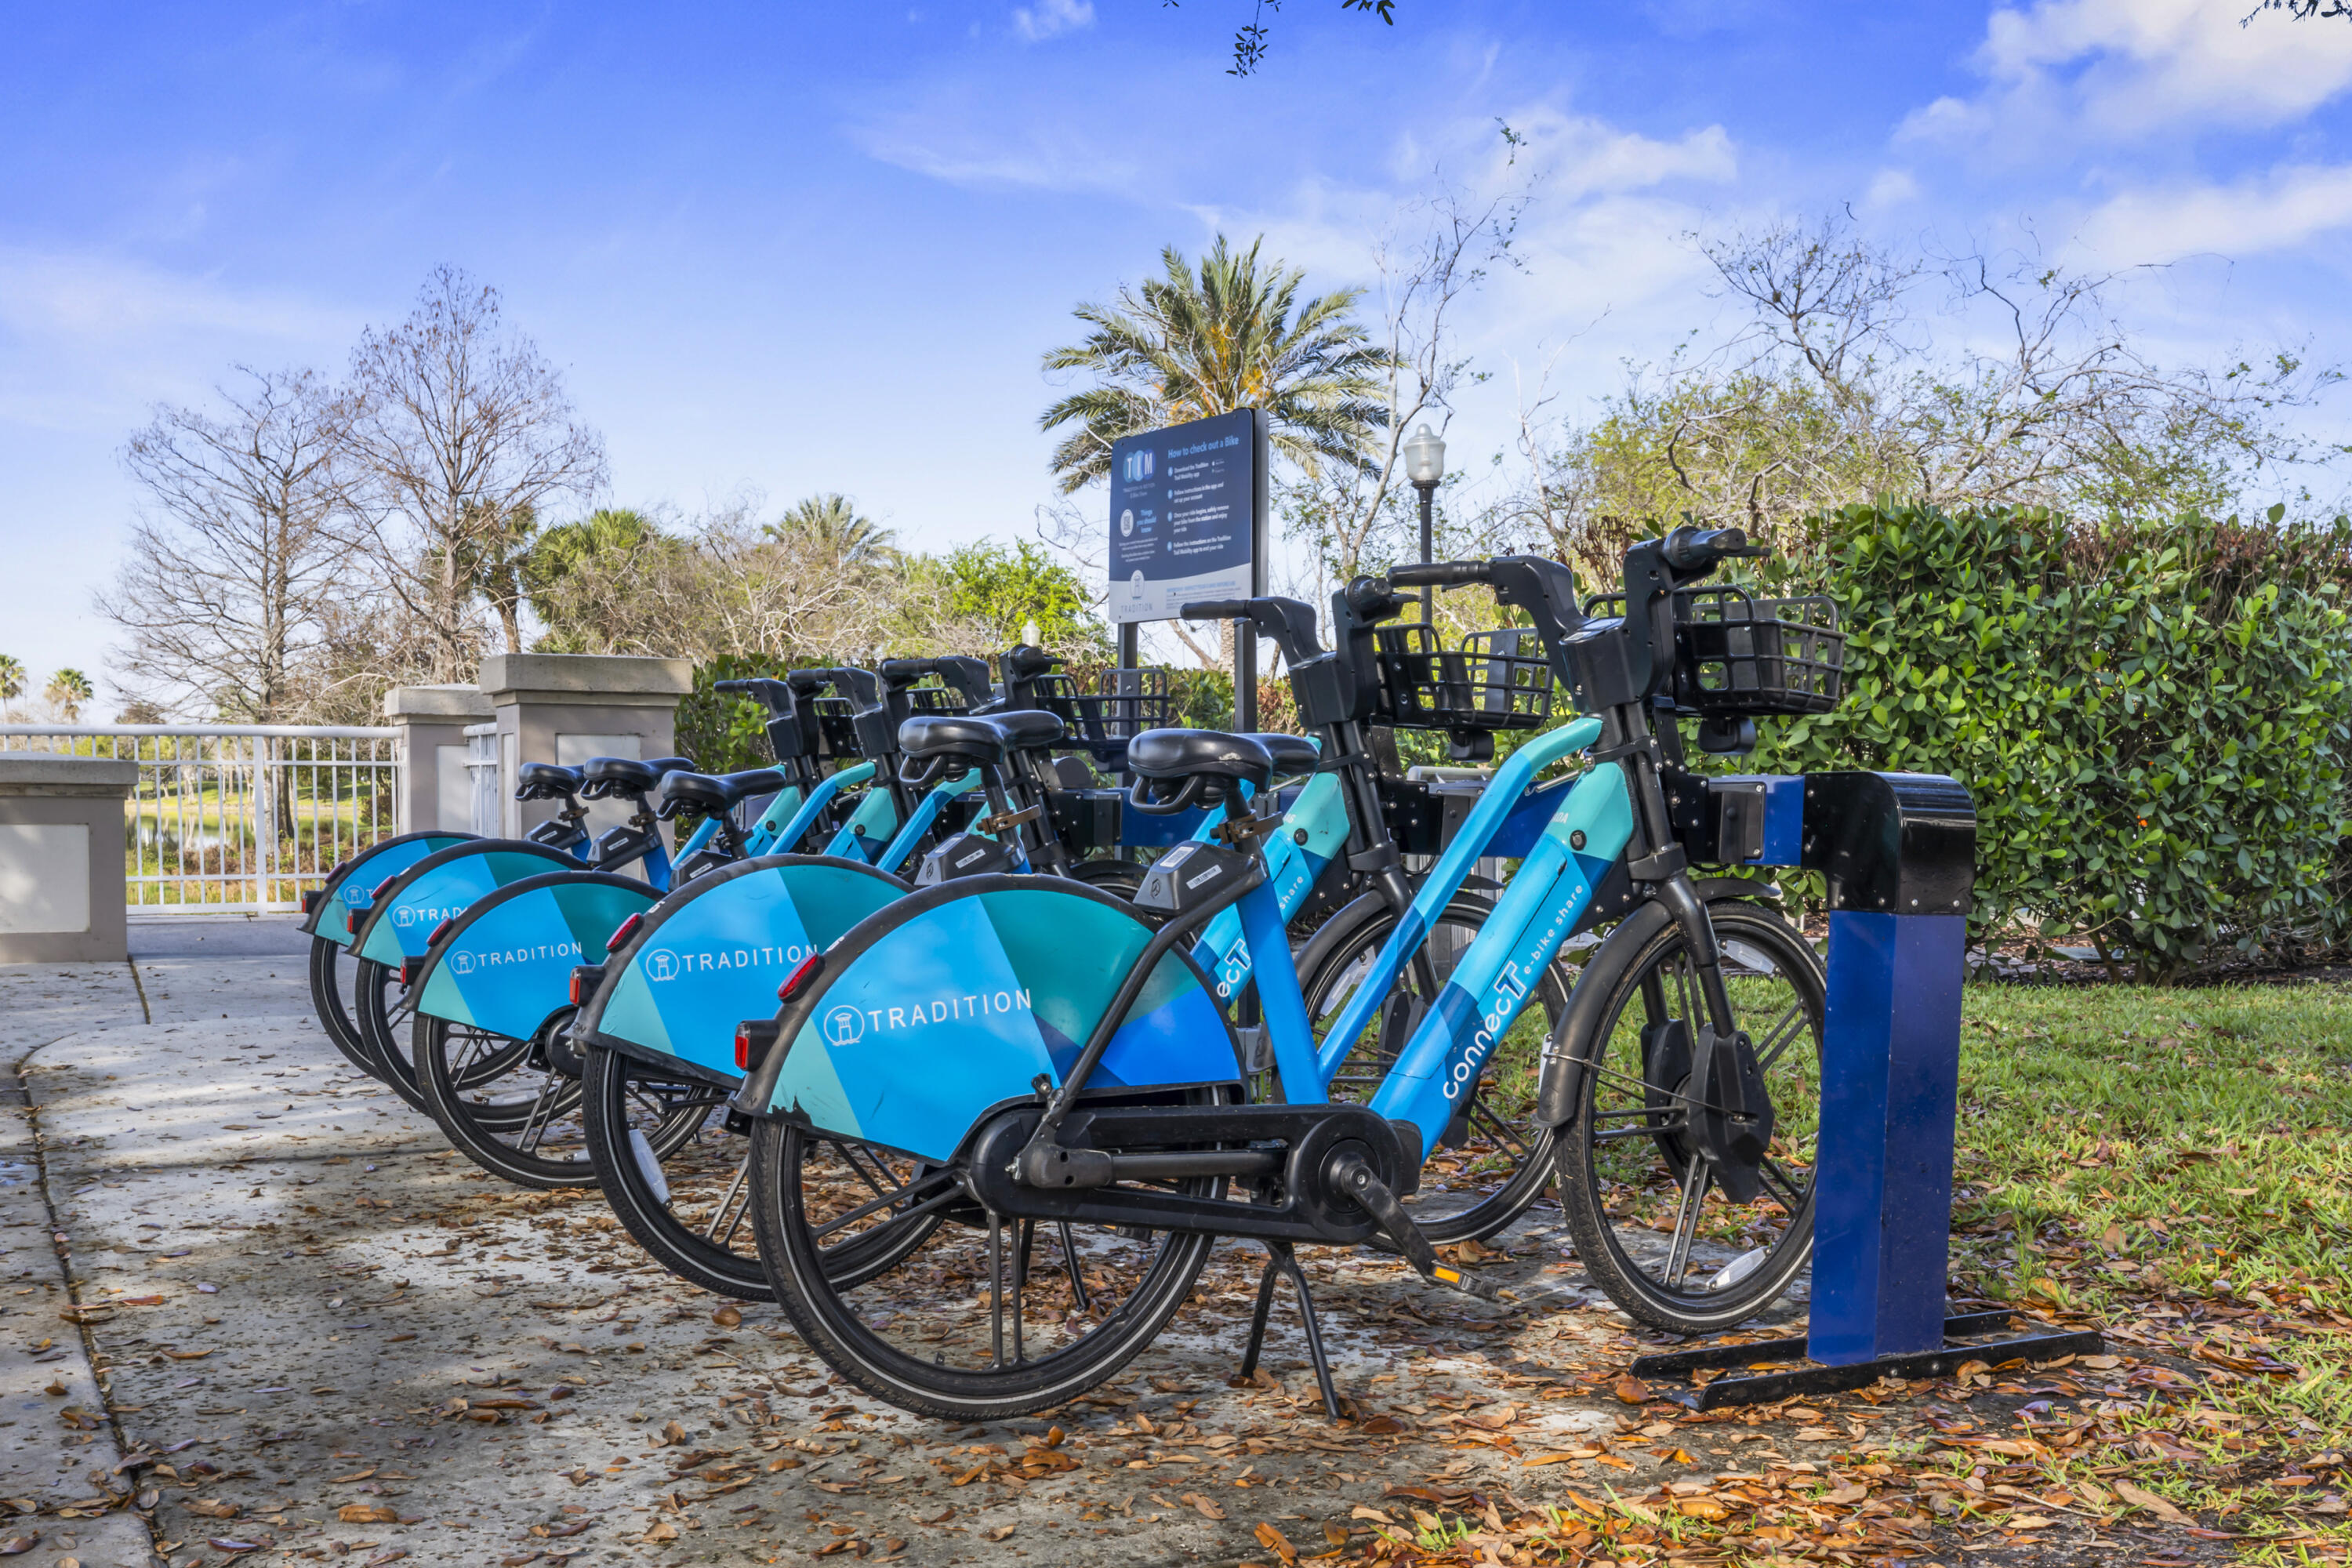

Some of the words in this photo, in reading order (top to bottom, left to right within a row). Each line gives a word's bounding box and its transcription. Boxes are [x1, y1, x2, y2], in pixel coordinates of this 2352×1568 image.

[1168, 448, 1181, 459] How
[1182, 447, 1189, 456] to
[1190, 442, 1207, 455] check
[1208, 441, 1218, 450] out
[1225, 435, 1239, 447] Bike
[1127, 453, 1153, 477] TIM
[1120, 603, 1153, 614] TRADITION
[1279, 875, 1305, 910] share
[1523, 927, 1556, 975] e-bike
[1555, 884, 1584, 927] share
[477, 941, 583, 967] TRADITION
[682, 944, 818, 972] TRADITION
[867, 988, 1032, 1033] TRADITION
